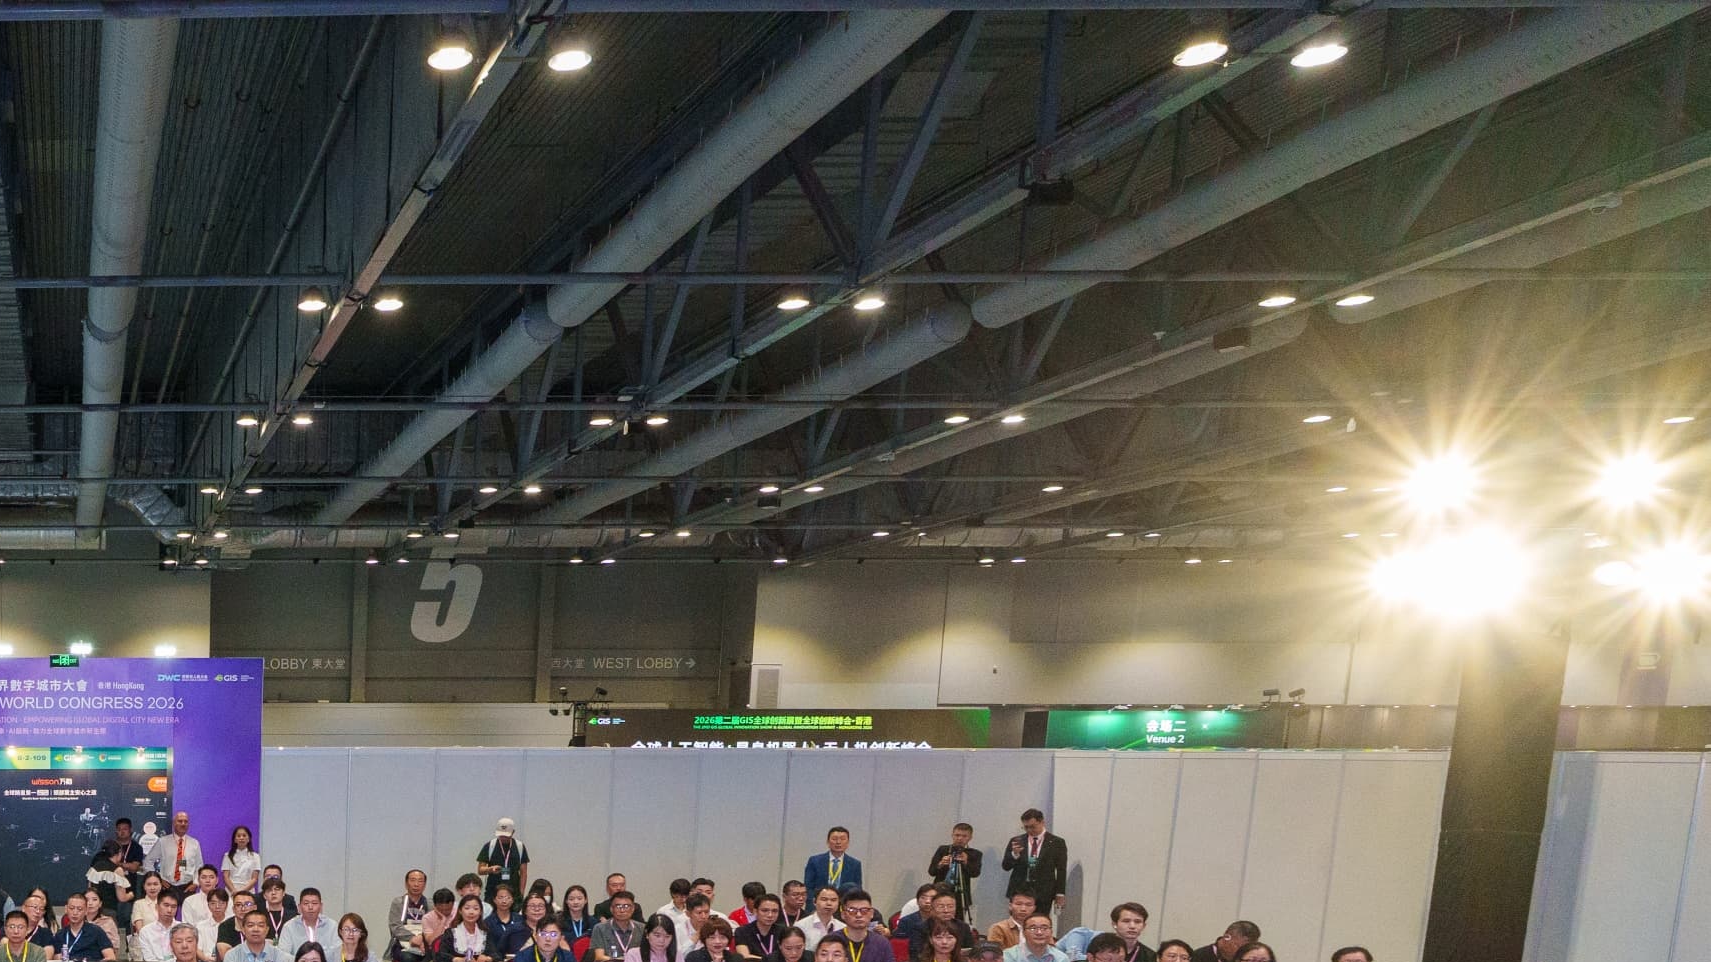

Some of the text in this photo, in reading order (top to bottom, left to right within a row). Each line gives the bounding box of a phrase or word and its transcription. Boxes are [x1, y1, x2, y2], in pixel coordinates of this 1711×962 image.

[410, 546, 488, 643] 5
[593, 657, 633, 669] WEST
[636, 657, 683, 669] LOBBY
[157, 674, 181, 682] DWC
[223, 674, 238, 682] GIS
[0, 697, 54, 709] WORLD
[58, 696, 143, 710] CONGRESS
[147, 696, 184, 710] 2026
[103, 716, 129, 724] DIGITAL
[130, 716, 146, 724] CITY
[148, 716, 165, 724] NEW
[166, 716, 180, 724] ERA
[598, 717, 611, 725] GIS
[1146, 720, 1186, 732] 会场二
[1146, 735, 1185, 744] Venue 2
